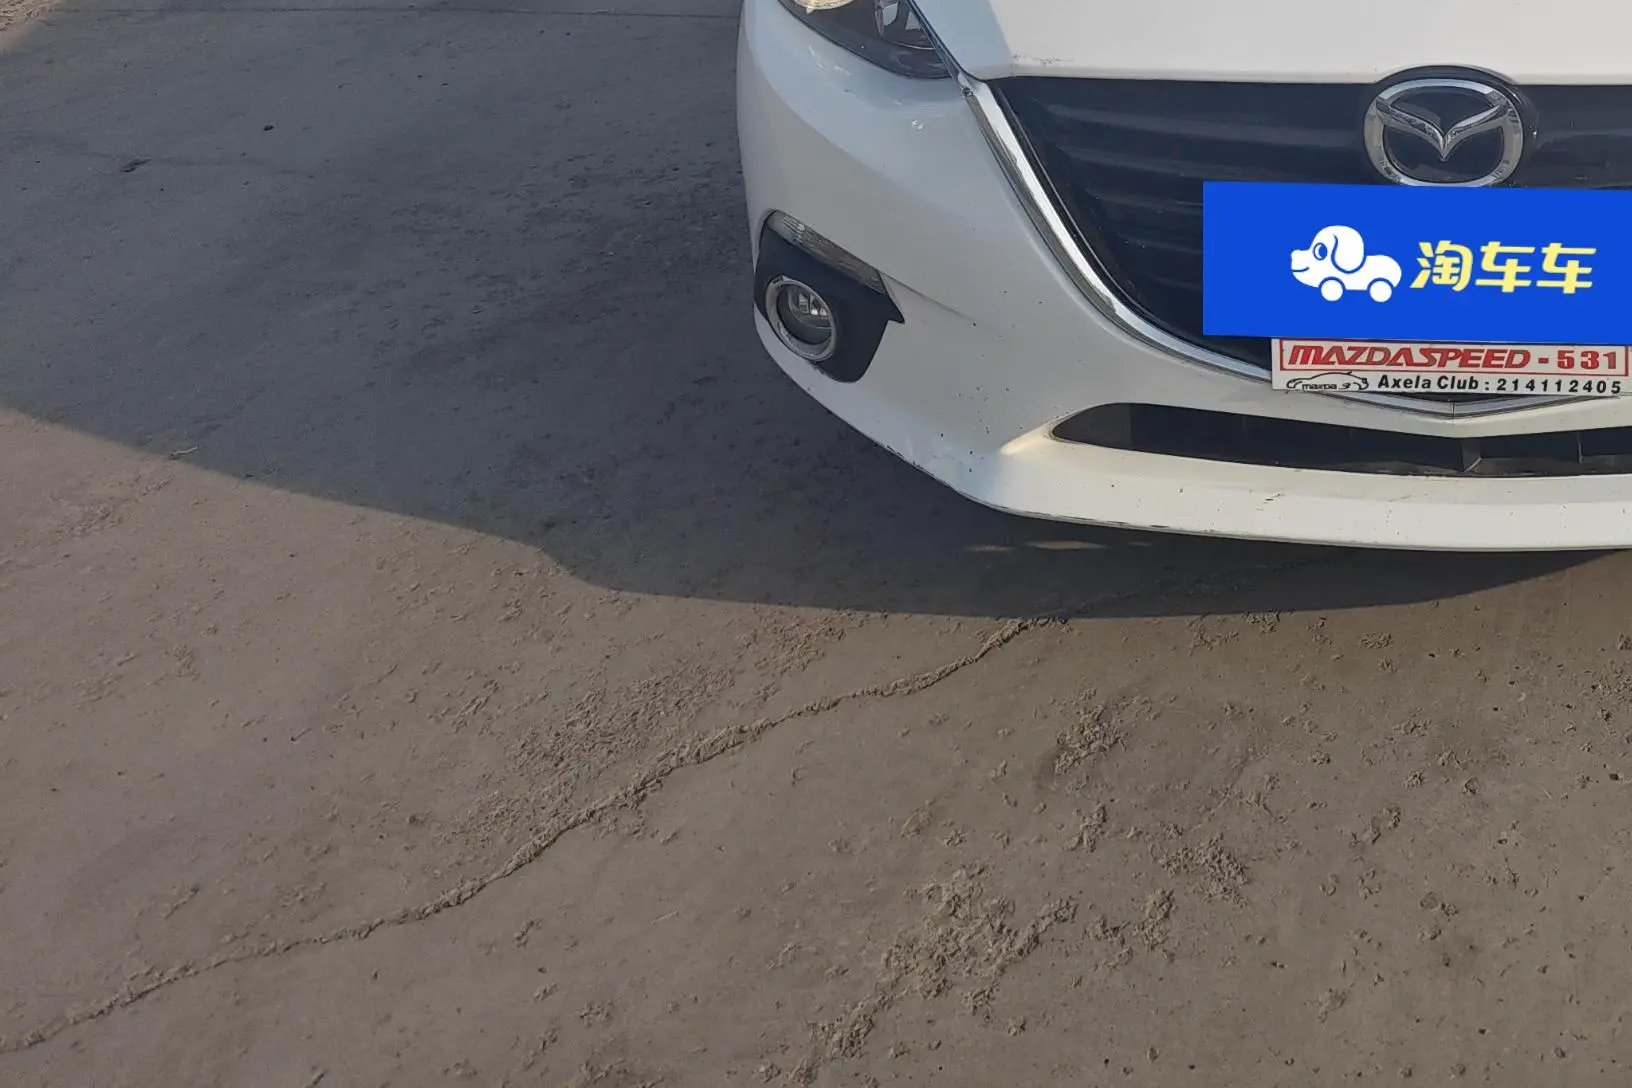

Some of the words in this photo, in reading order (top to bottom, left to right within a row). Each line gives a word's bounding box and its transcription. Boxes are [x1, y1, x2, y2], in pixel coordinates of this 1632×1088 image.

[1288, 344, 1531, 369] MAZDASPEED
[1557, 350, 1616, 370] 531
[1378, 374, 1431, 389] Axela
[1497, 378, 1621, 394] 214112405
